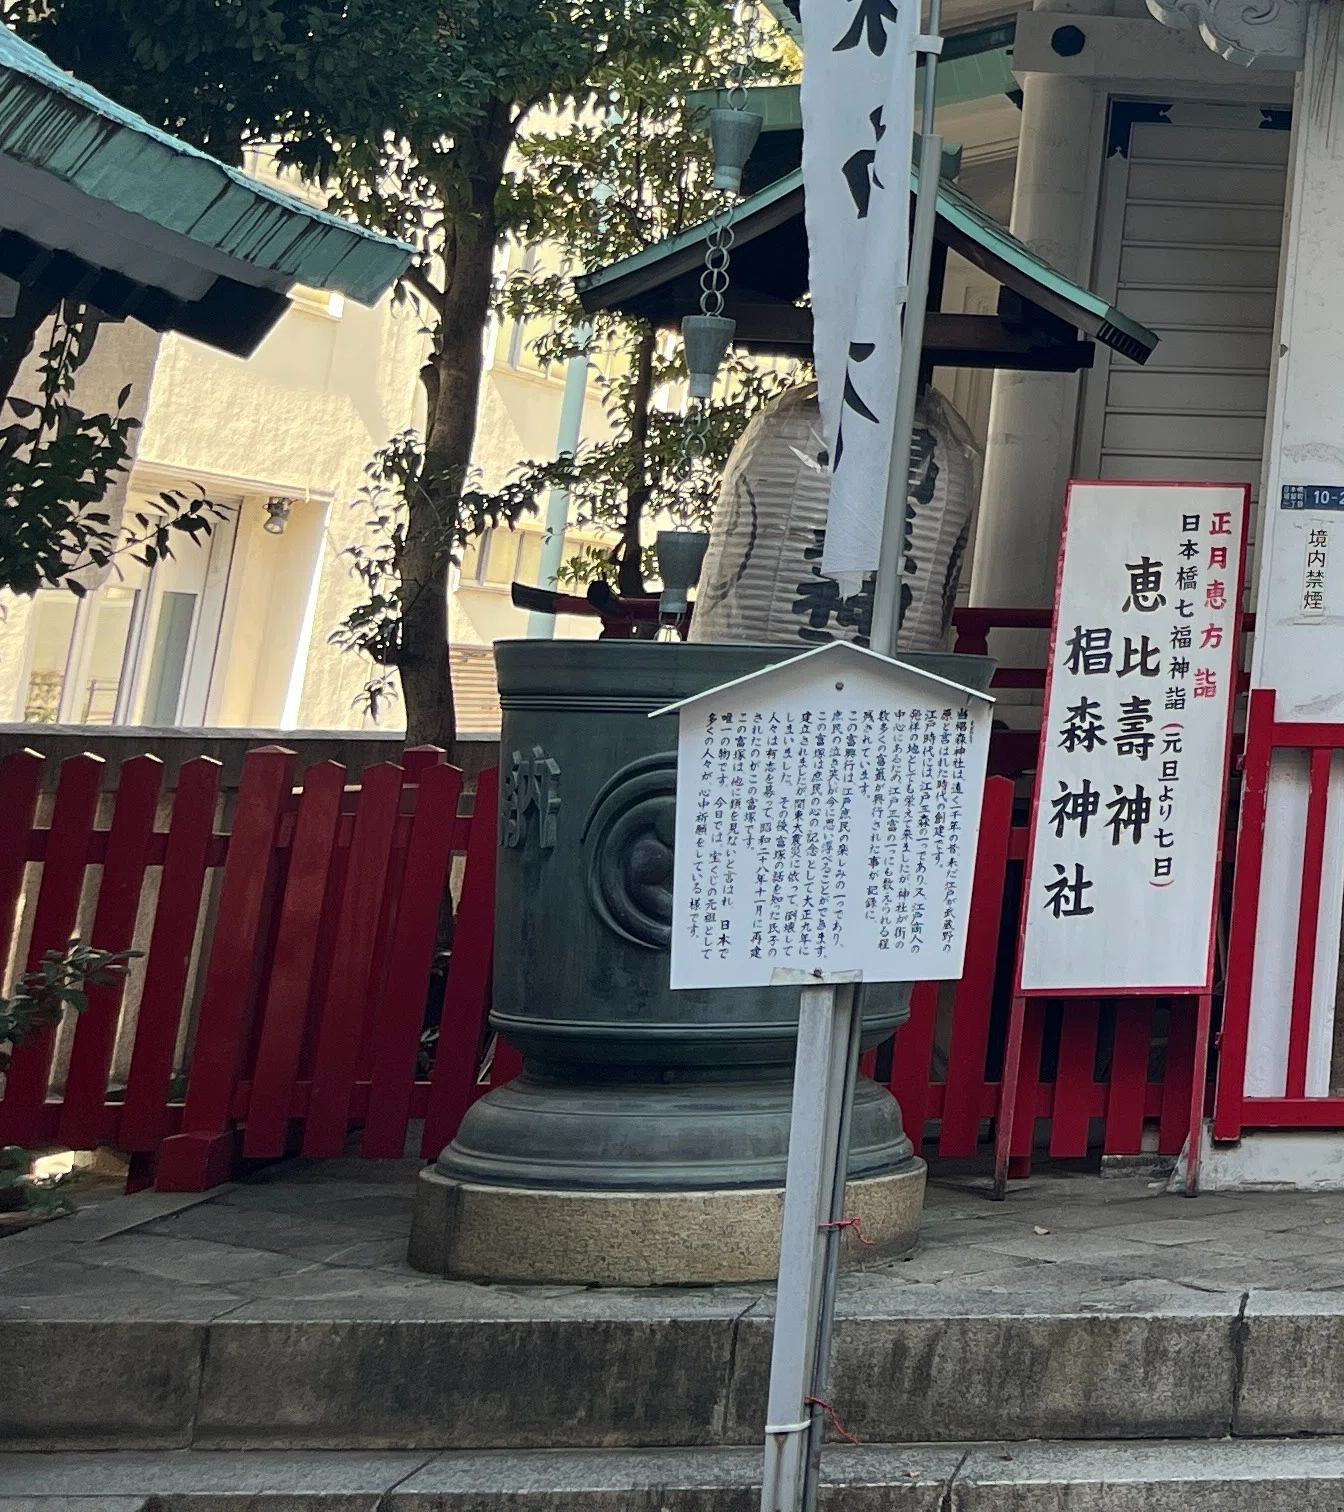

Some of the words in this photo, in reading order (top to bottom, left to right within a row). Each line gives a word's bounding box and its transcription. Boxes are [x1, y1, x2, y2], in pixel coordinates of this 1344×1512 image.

[1192, 510, 1233, 700] 正月恵方詣
[1303, 528, 1329, 610] 境内禁煙
[1042, 624, 1114, 920] 椙森神社
[1103, 555, 1167, 847] 恵比壽神
